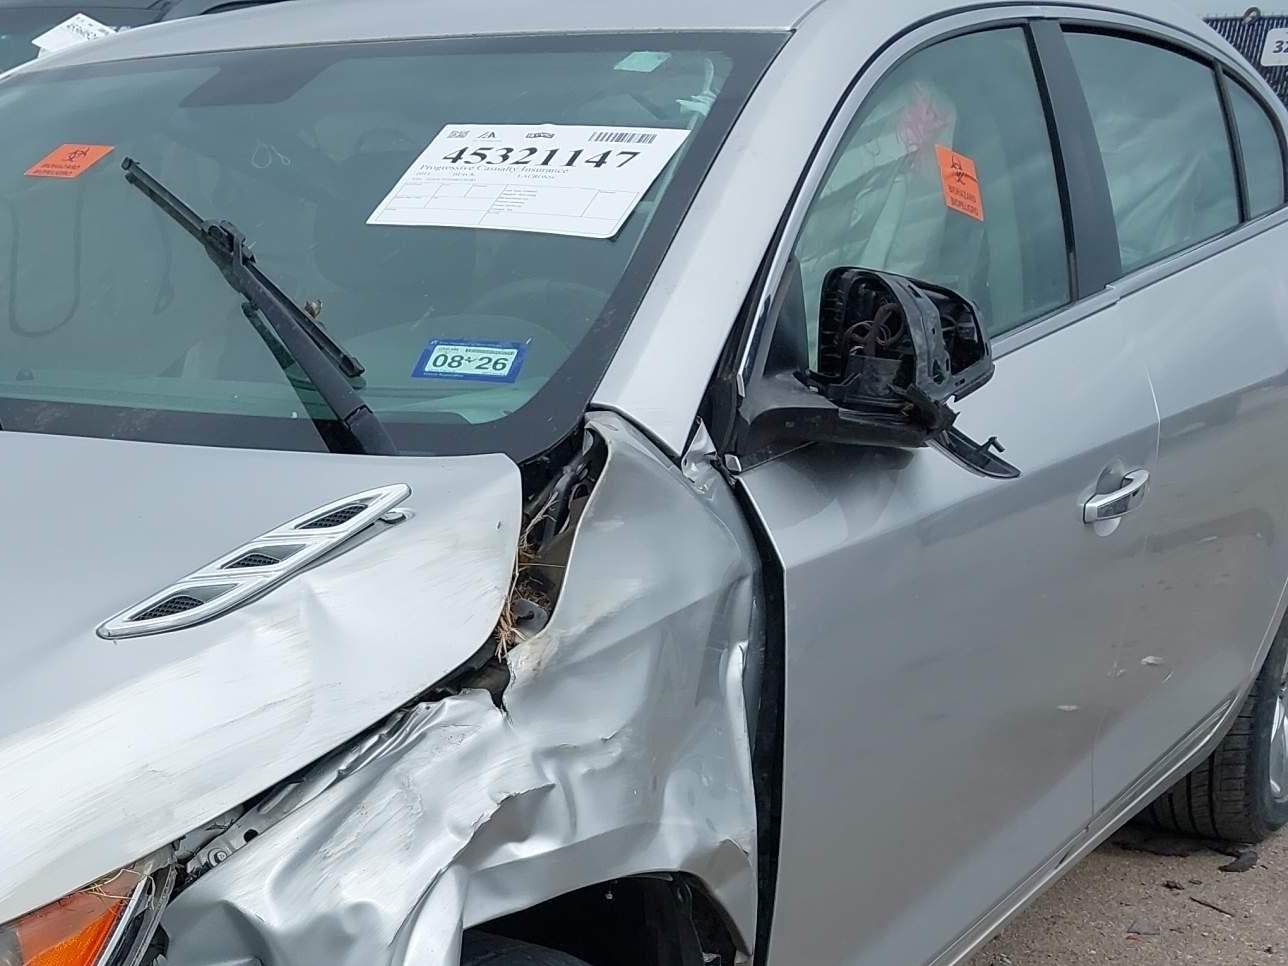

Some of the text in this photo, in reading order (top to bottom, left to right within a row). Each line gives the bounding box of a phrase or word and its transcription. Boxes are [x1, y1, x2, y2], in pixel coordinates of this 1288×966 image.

[442, 146, 640, 169] 45321147
[420, 164, 475, 172] Progressive
[521, 167, 569, 175] Insurance
[432, 353, 509, 371] 08 26
